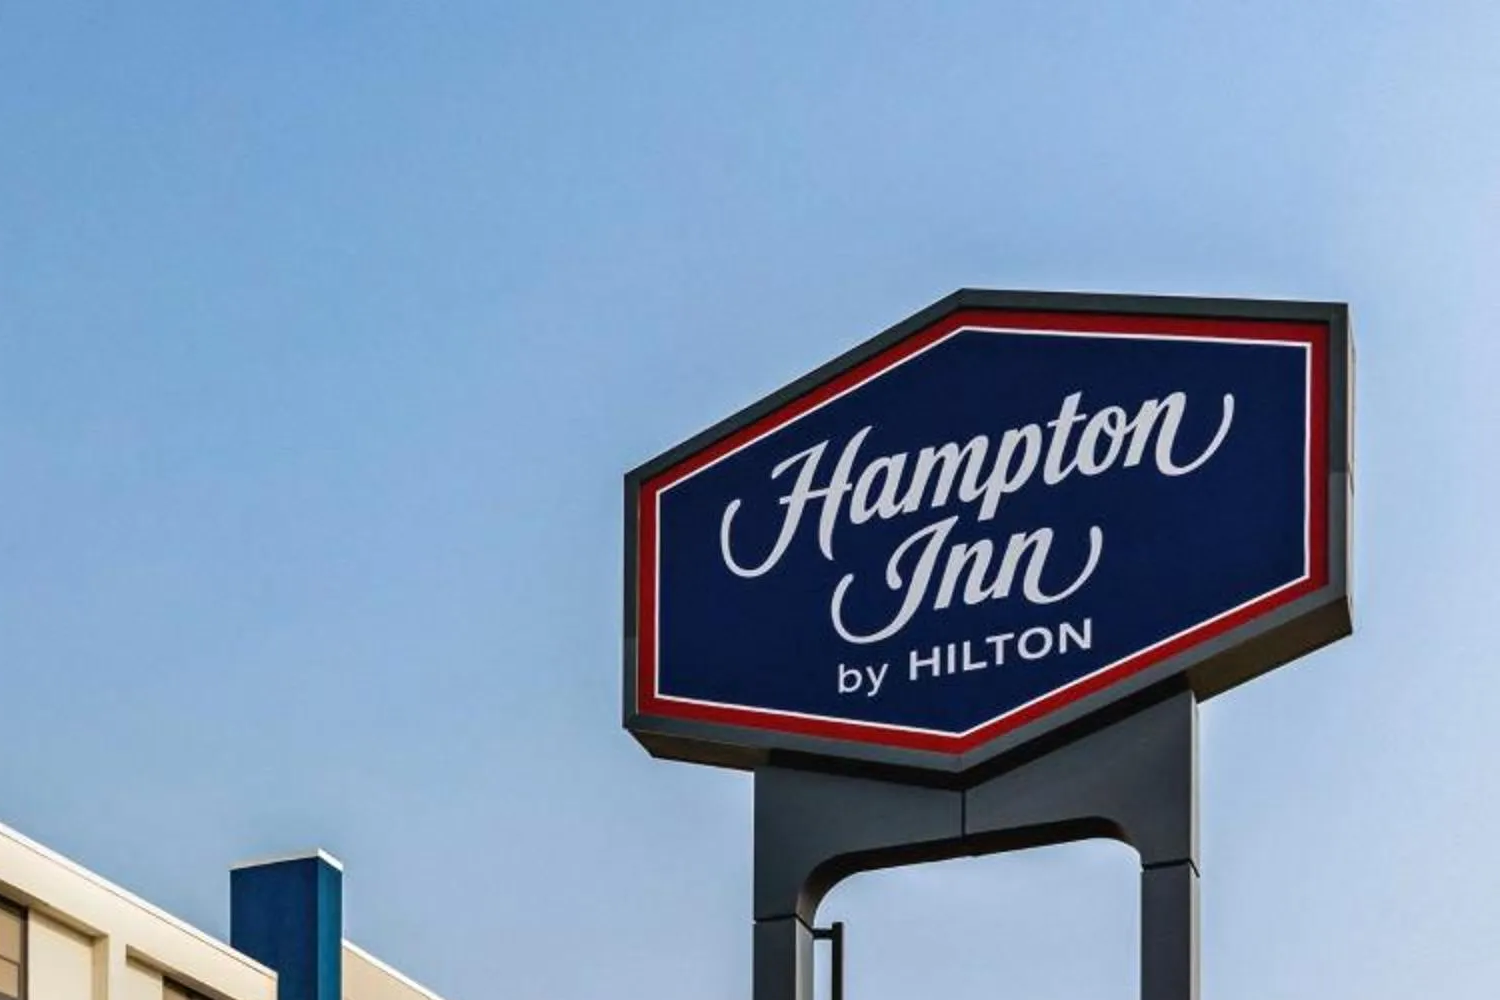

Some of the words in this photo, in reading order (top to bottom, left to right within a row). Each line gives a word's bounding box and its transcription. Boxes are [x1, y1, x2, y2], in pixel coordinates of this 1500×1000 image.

[720, 391, 1234, 577] Hampton
[831, 516, 1102, 644] Inn
[837, 662, 889, 697] by
[909, 617, 1093, 682] HILTON
